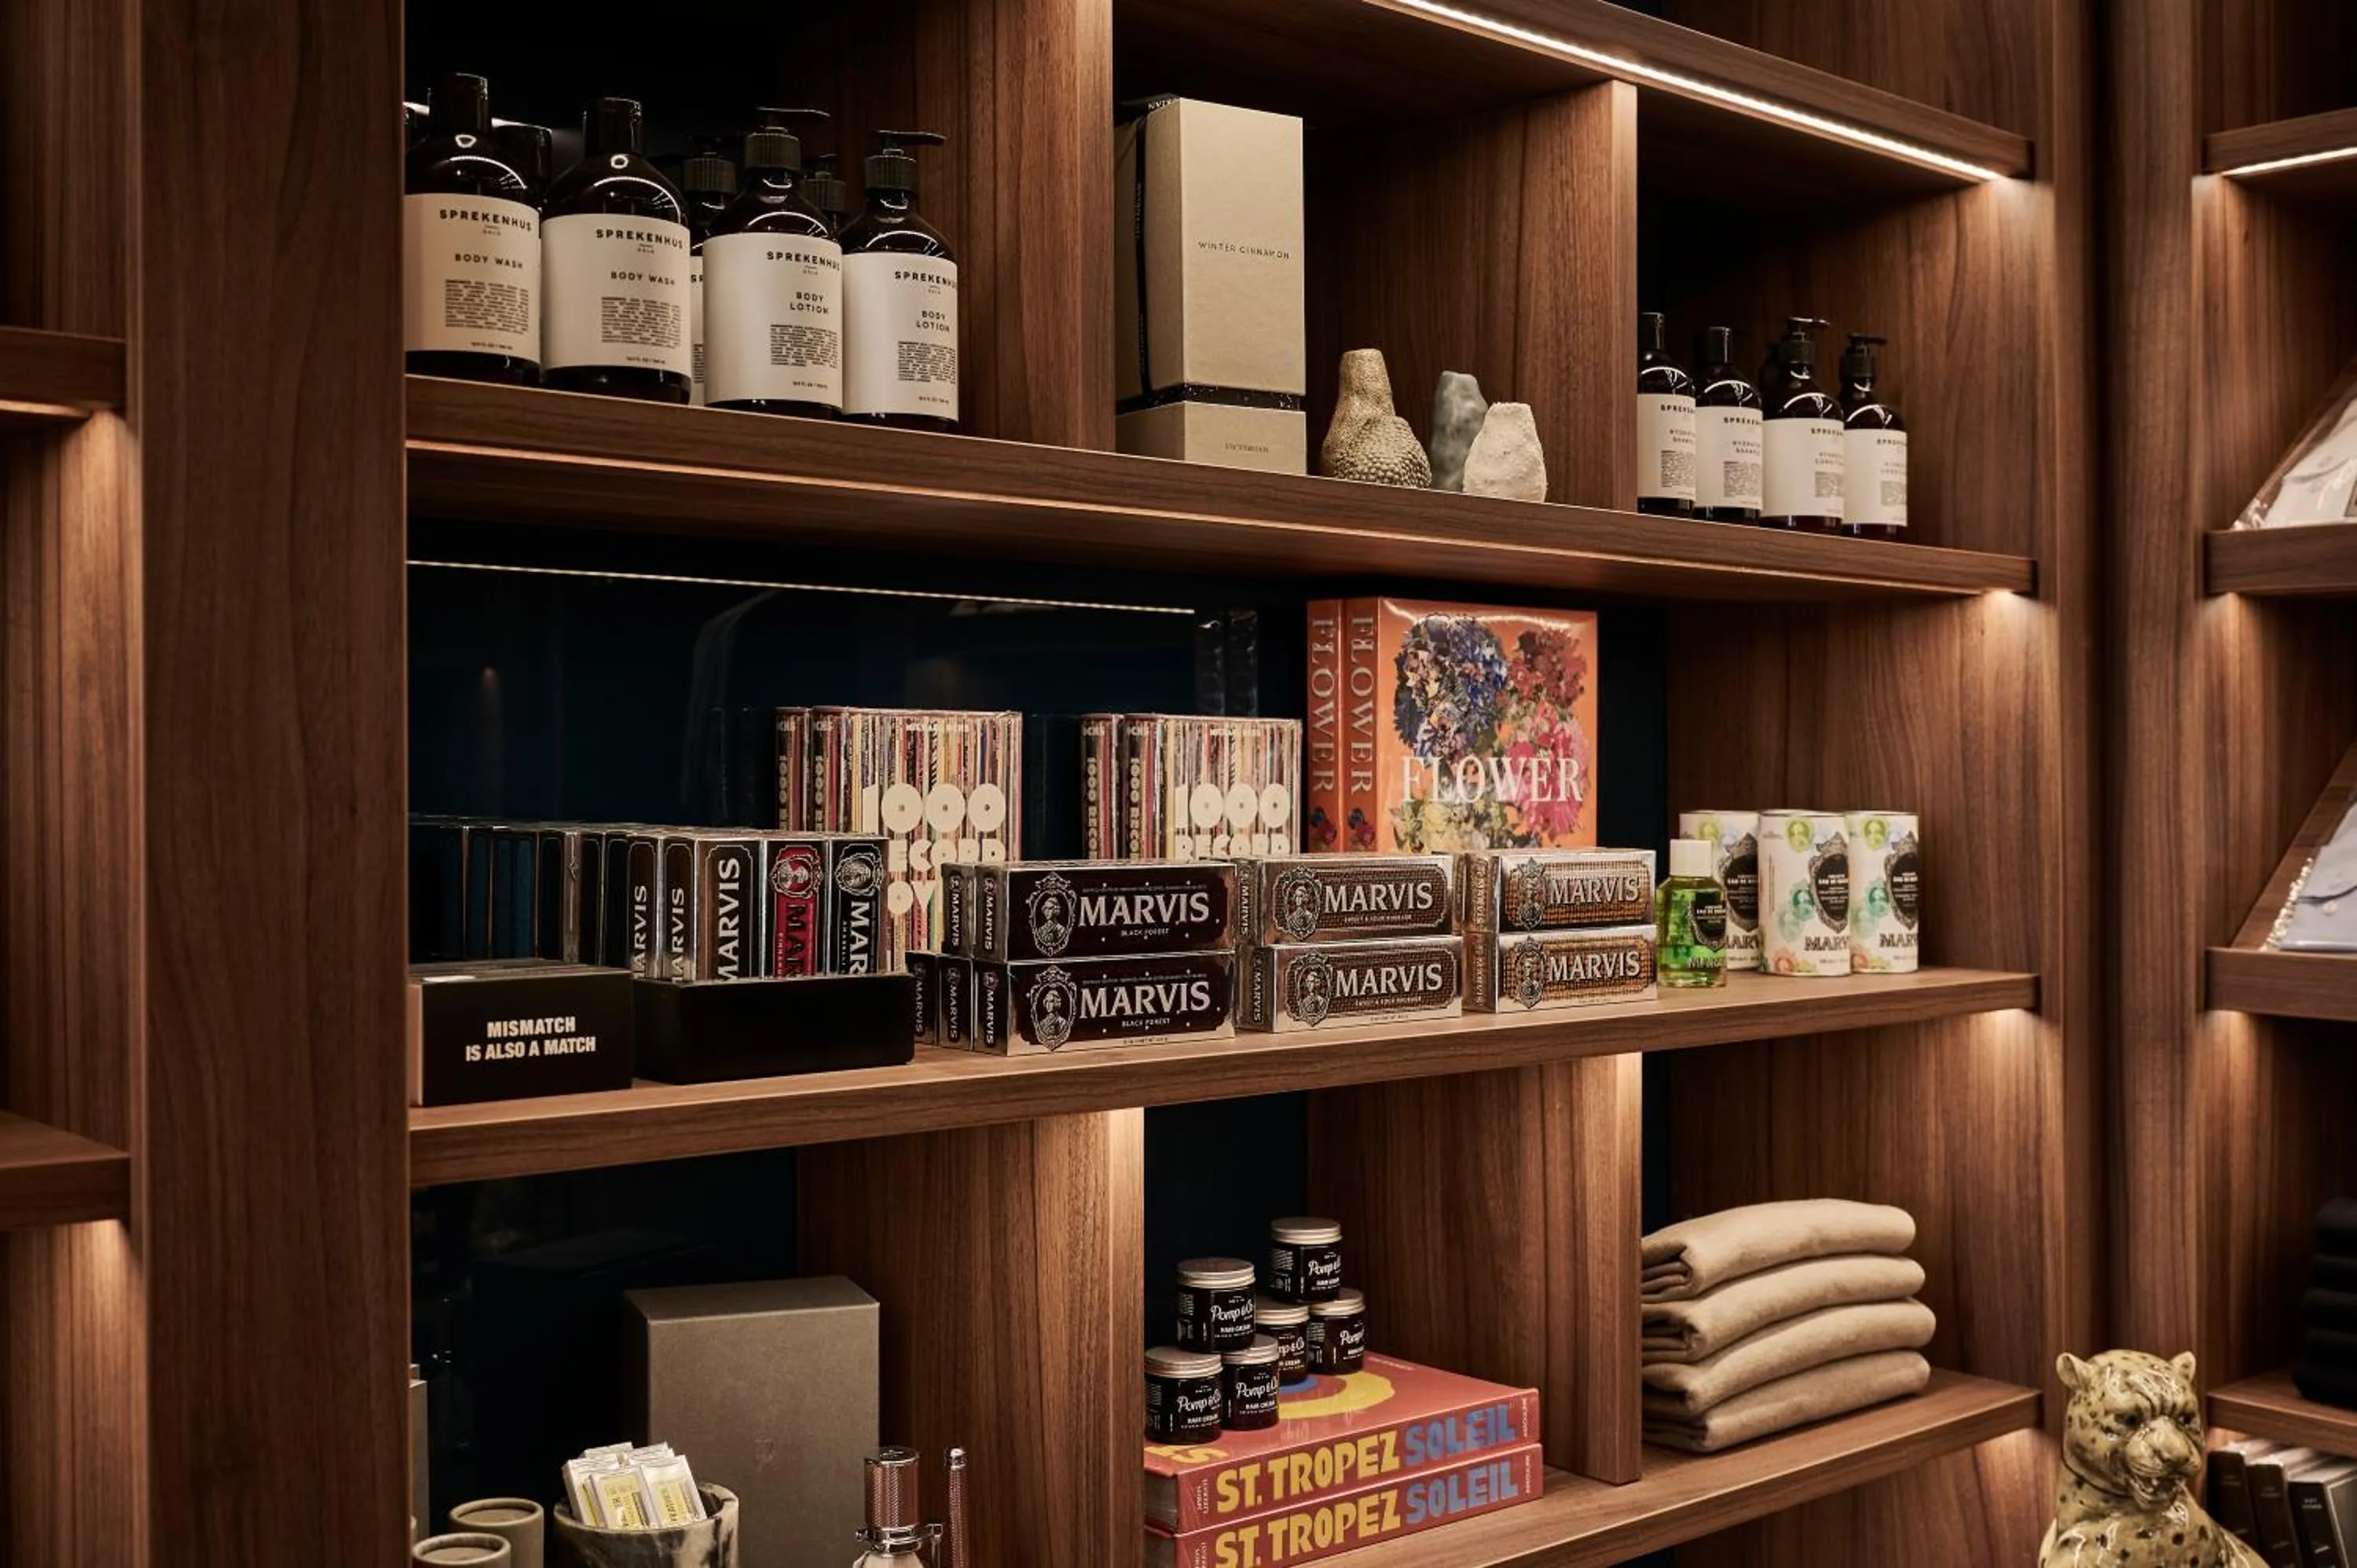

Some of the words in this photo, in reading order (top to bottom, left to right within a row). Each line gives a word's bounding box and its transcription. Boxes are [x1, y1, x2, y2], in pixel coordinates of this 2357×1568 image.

[438, 208, 532, 233] SPREKENHUS
[596, 228, 684, 250] SPREKENHUS
[454, 253, 489, 264] BODY
[1197, 241, 1237, 252] WINTER
[1238, 246, 1289, 260] CINNAMON
[610, 271, 643, 280] BODY
[790, 302, 830, 315] LOTION
[796, 291, 824, 302] BODY
[915, 320, 950, 332] LOTION
[1311, 619, 1335, 793] FLOWER
[1351, 616, 1374, 795] FLOWER
[1401, 754, 1583, 803] FLOWER
[862, 782, 1006, 834] 1000
[1175, 782, 1291, 830] 1000
[888, 838, 1007, 873] ECORD
[1324, 881, 1434, 914] MARVIS
[1550, 875, 1641, 905] MARVIS
[950, 891, 961, 947] MARVIS
[984, 893, 994, 951] MARVIS
[1078, 892, 1210, 927] MARVIS
[1240, 885, 1250, 936] MARVIS
[787, 904, 805, 977] MAR
[849, 901, 870, 976] MAR
[1336, 963, 1443, 997] MARVIS
[1549, 951, 1641, 982] MARVIS
[915, 980, 924, 1033] MARVIS
[949, 984, 959, 1039] MARVIS
[1079, 981, 1211, 1019] MARVIS
[1252, 973, 1263, 1022] MARVIS
[486, 1015, 576, 1039] MISMATCH
[986, 989, 995, 1045] MARVIS
[465, 1045, 482, 1061] IS
[485, 1041, 526, 1061] ALSO
[528, 1040, 540, 1057] A
[544, 1035, 596, 1056] MATCH
[1216, 1463, 1263, 1513] ST.
[1267, 1430, 1401, 1501] TROPEZ
[1404, 1403, 1516, 1467] SOLEIL
[1215, 1524, 1262, 1568] ST.
[1267, 1488, 1401, 1562] TROPEZ
[1406, 1460, 1519, 1525] SOLEIL
